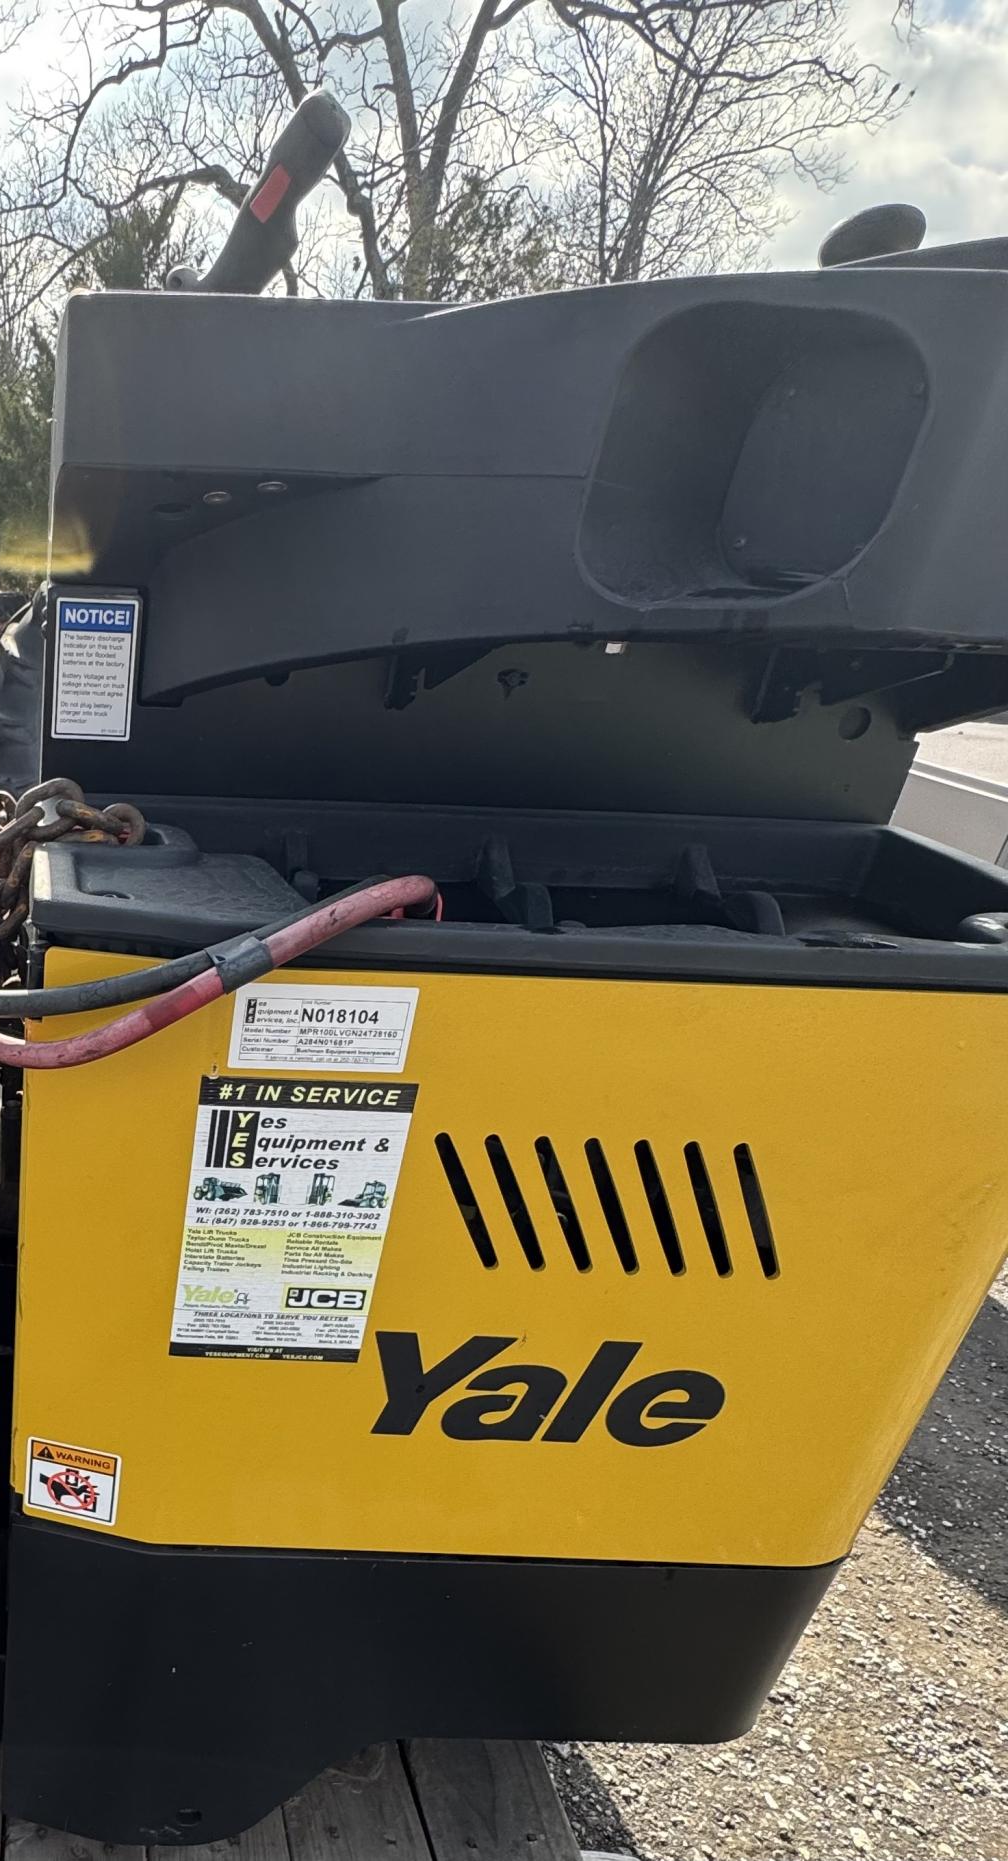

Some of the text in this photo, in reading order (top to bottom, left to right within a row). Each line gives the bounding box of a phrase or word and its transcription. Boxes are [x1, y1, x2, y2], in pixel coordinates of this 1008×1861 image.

[301, 1008, 379, 1024] N018104
[219, 1084, 401, 1106] #1 IN SERVICE
[374, 1138, 390, 1152] &
[214, 1208, 240, 1216] (262)
[243, 1208, 289, 1217] 783-7510
[305, 1211, 381, 1220] 1-888-310-3902
[212, 1217, 237, 1226] (847)
[241, 1219, 286, 1227] 928-9253
[302, 1221, 377, 1230] 1-866-799-7743
[184, 1285, 234, 1303] Yale
[288, 1290, 364, 1308] JCB
[371, 1331, 726, 1448] Yale
[56, 1451, 110, 1469] WARNING
